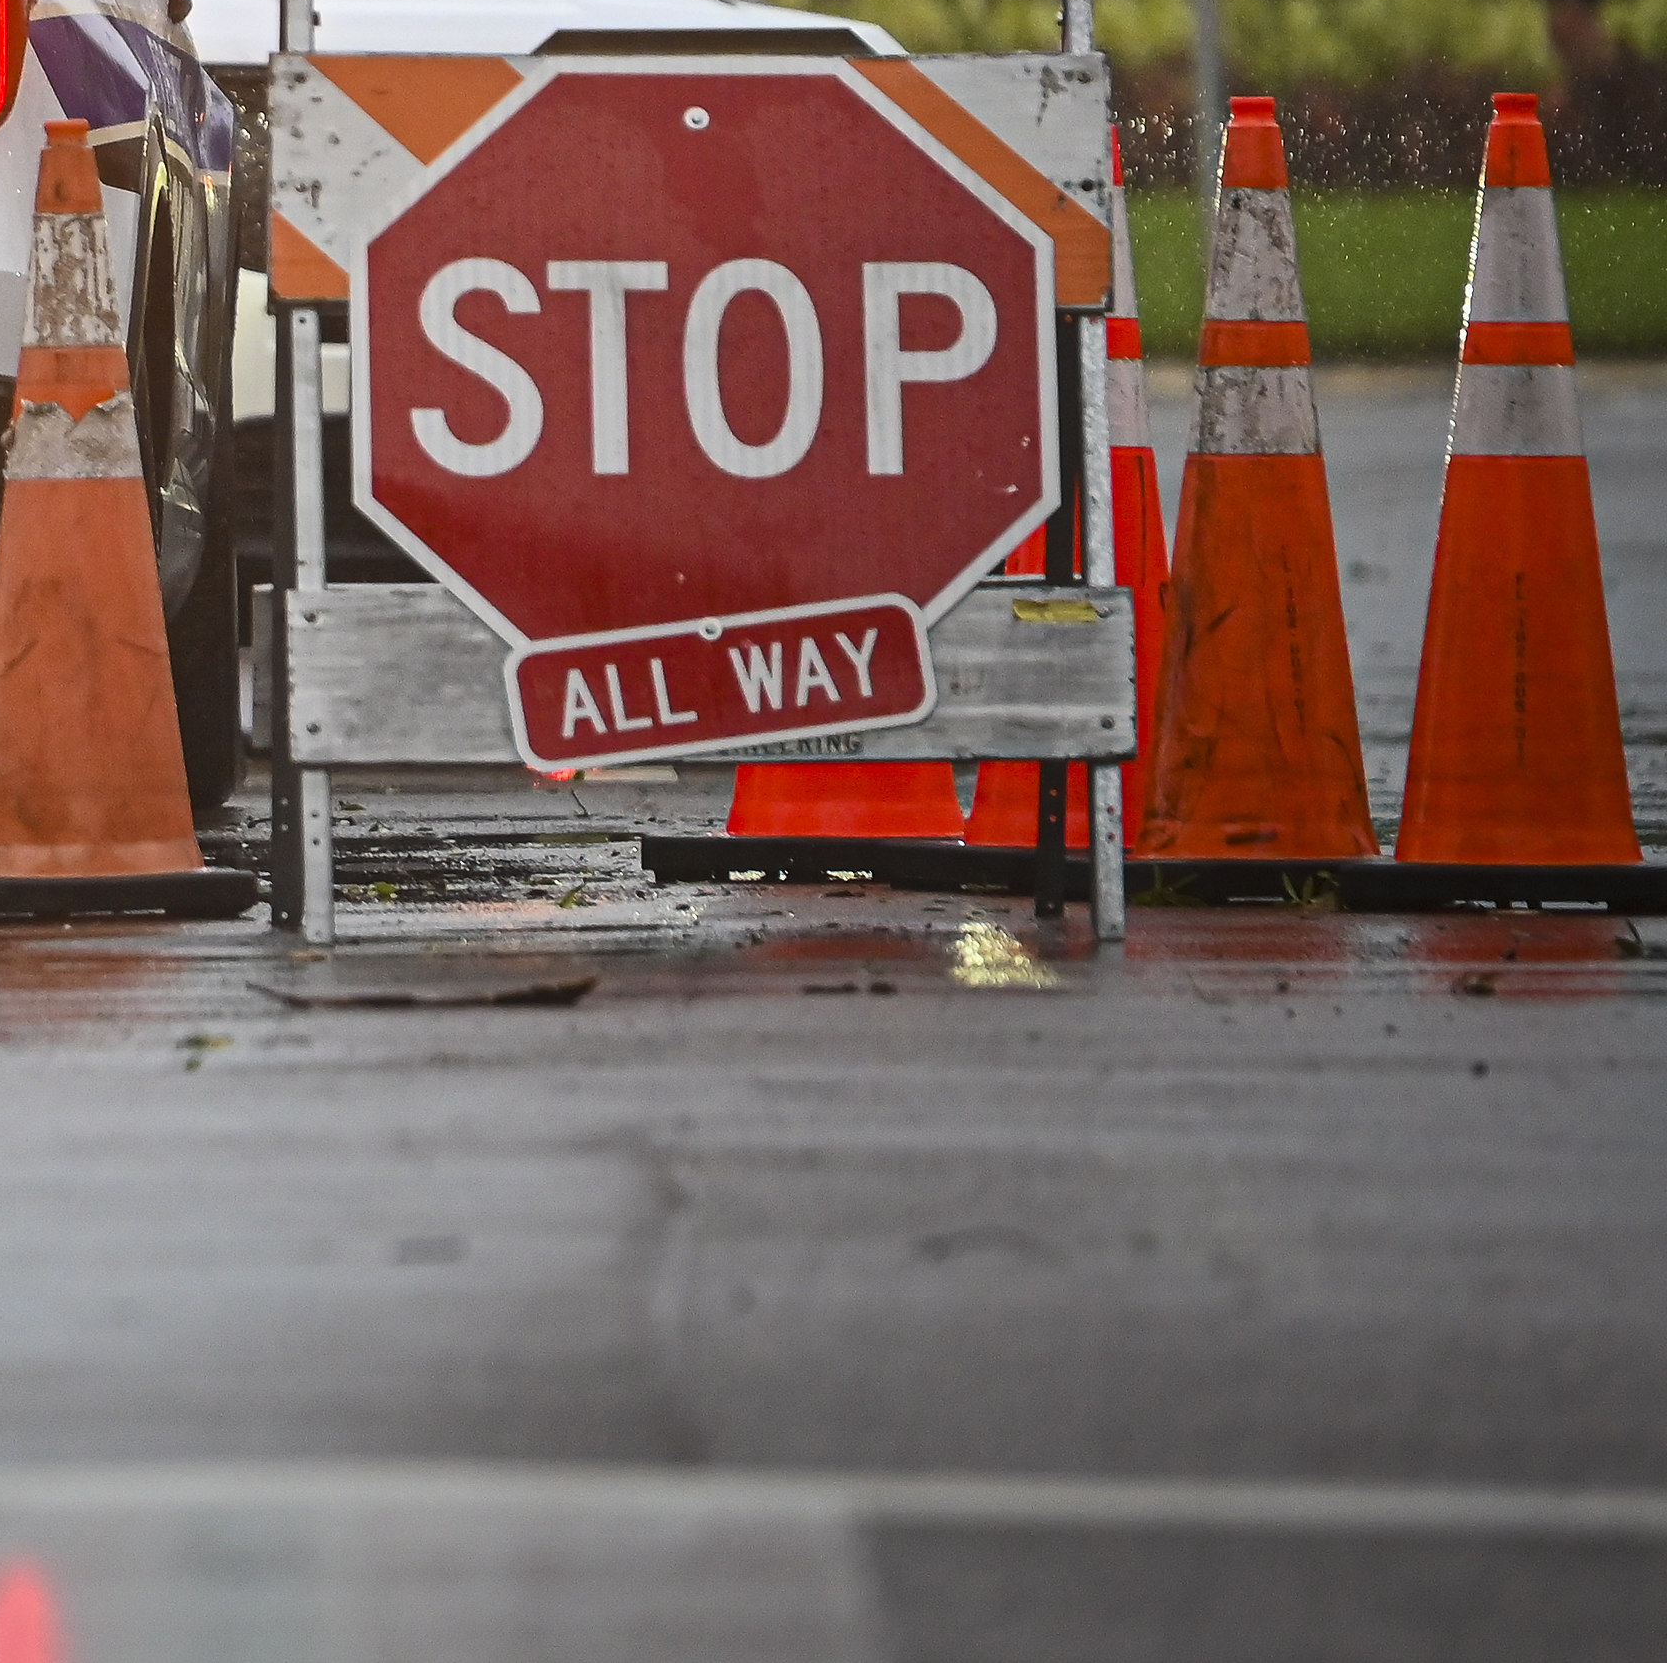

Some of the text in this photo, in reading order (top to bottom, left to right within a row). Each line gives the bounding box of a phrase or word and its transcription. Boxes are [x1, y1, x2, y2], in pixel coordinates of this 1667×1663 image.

[409, 257, 999, 480] STOP
[561, 627, 880, 740] ALL WAY
